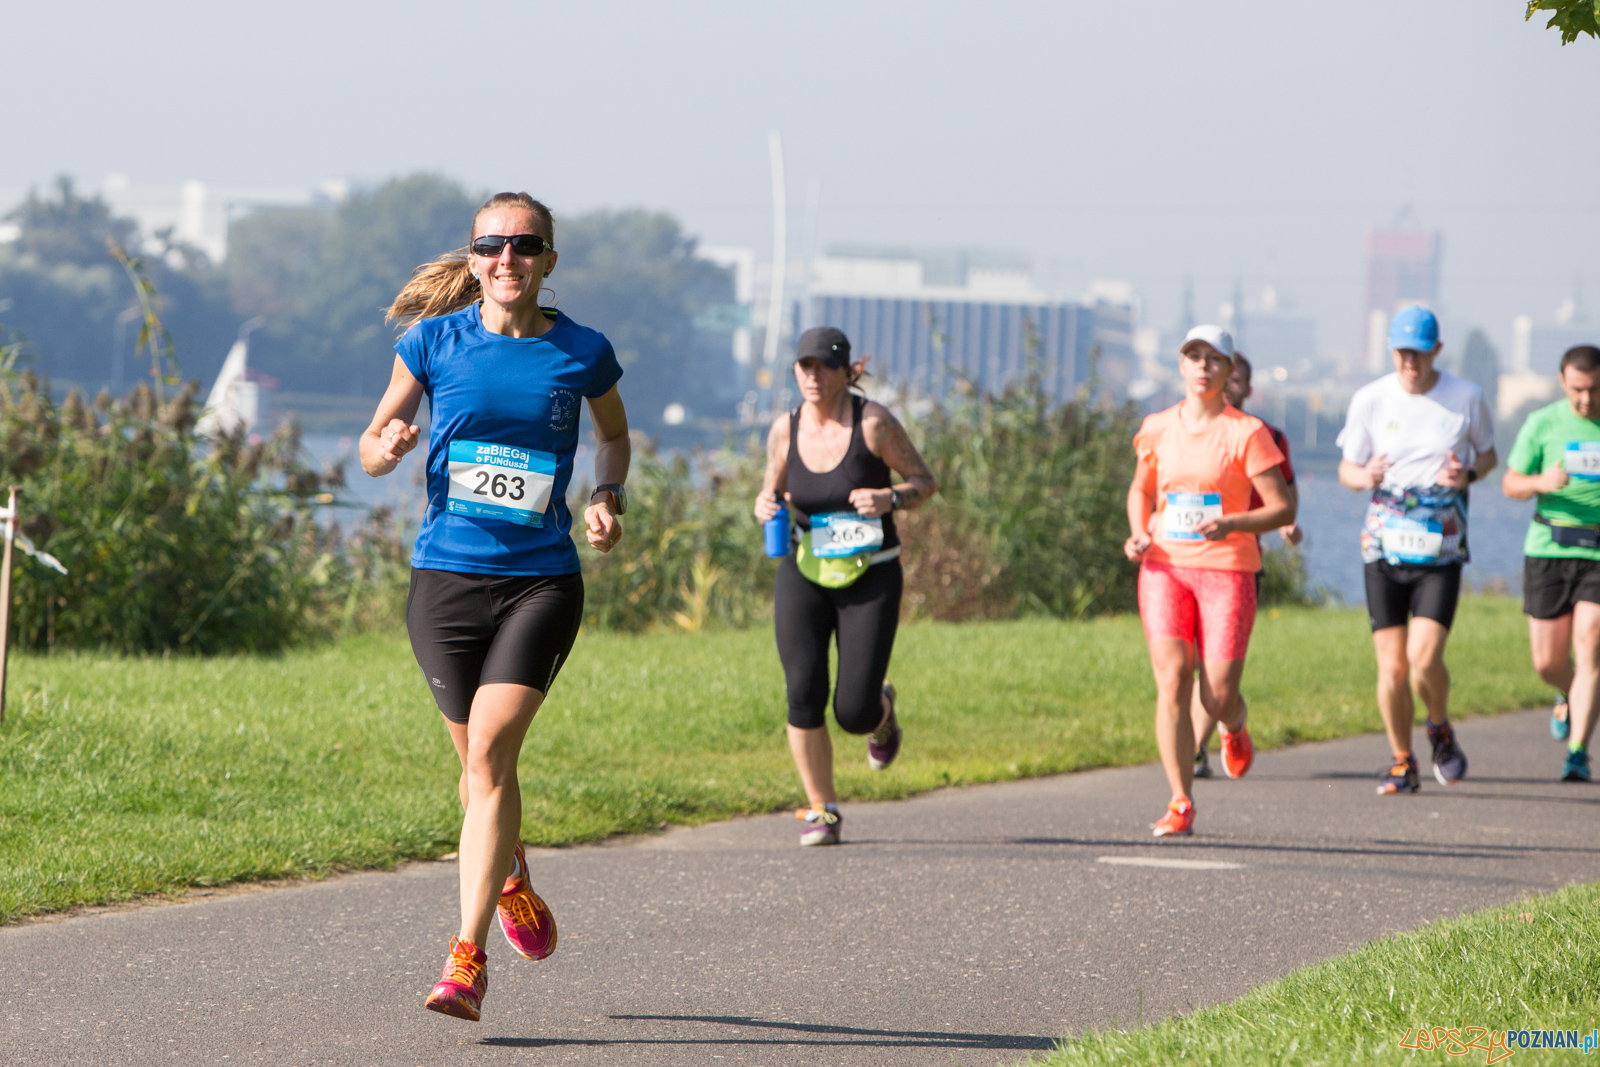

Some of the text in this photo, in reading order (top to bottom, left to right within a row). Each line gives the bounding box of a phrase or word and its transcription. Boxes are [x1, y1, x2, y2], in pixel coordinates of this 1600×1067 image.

[476, 445, 530, 463] zaBIEGaj
[484, 456, 529, 470] FUNdusze
[473, 471, 525, 501] 263
[1177, 511, 1204, 528] 152
[1400, 535, 1426, 550] 115
